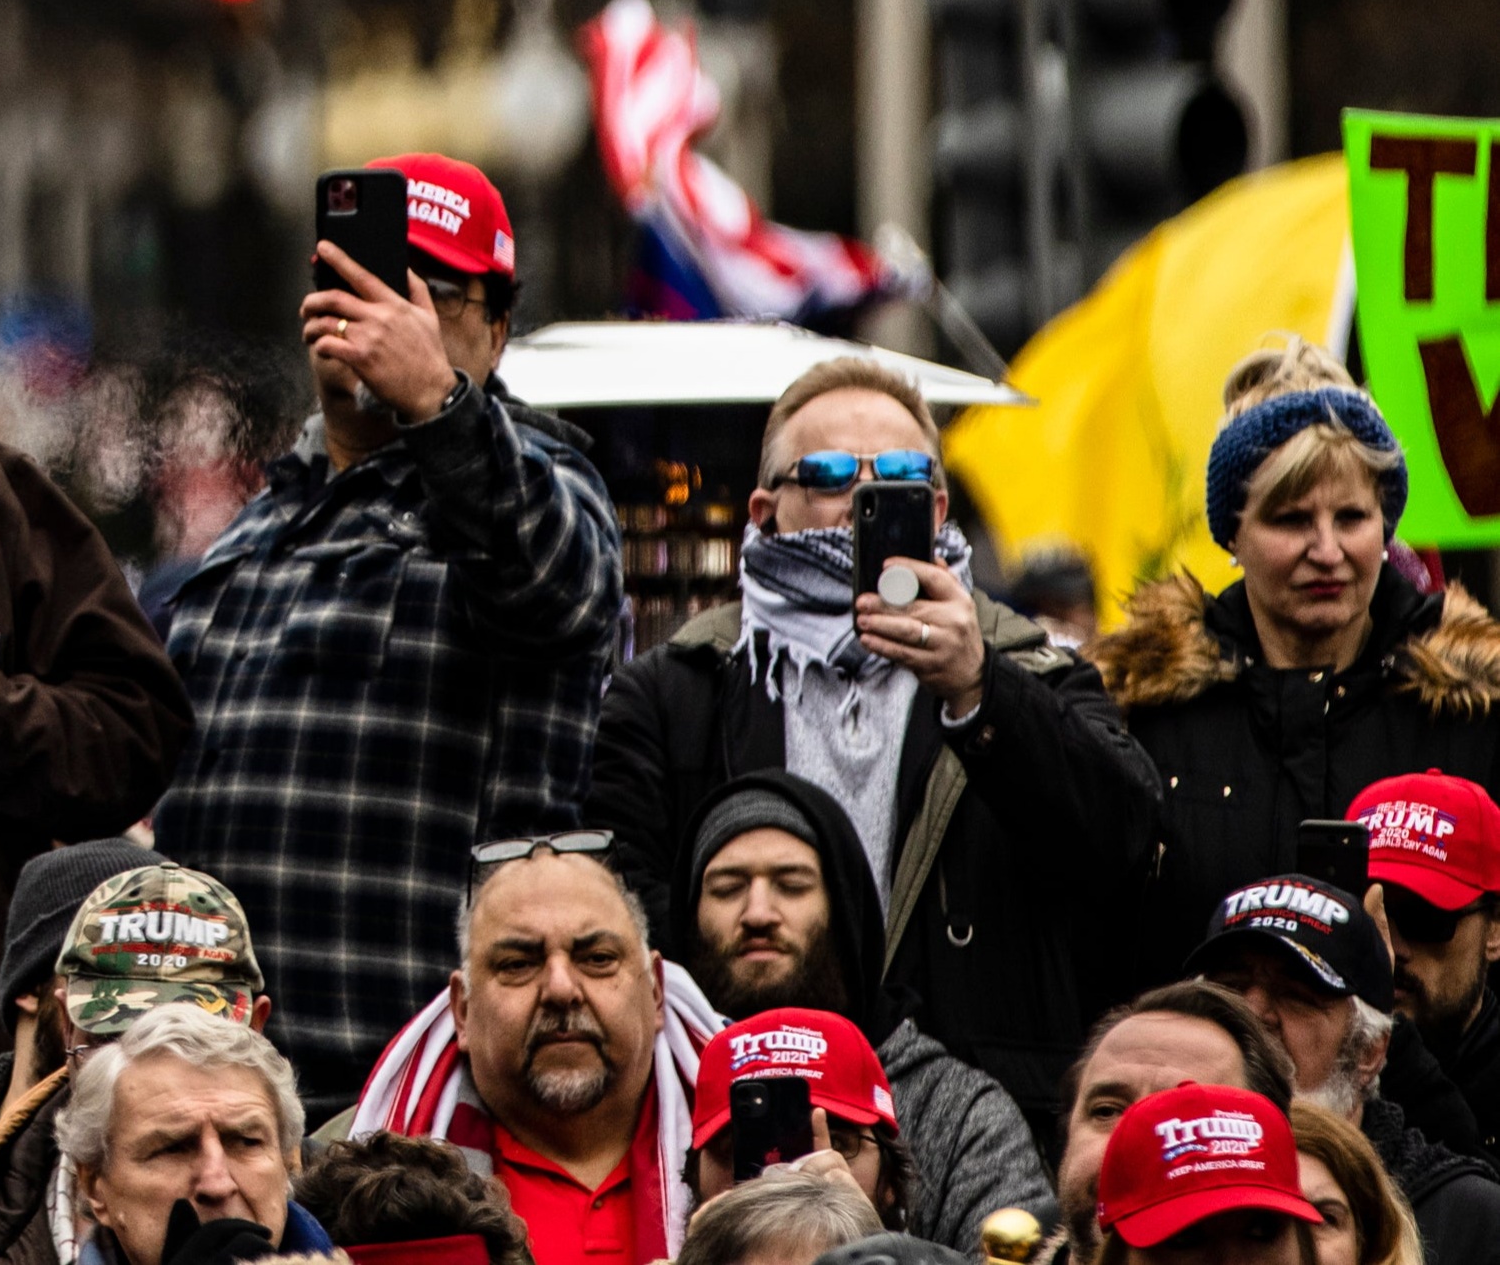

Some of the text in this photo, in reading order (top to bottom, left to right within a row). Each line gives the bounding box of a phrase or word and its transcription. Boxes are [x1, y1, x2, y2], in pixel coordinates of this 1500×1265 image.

[407, 178, 471, 220] MERICA
[1370, 136, 1500, 302] T
[1422, 844, 1449, 863] AGAIN
[1224, 884, 1350, 926] TRUMP
[99, 911, 230, 947] TRUMP
[1250, 916, 1298, 932] 2020
[137, 953, 188, 969] 2020
[730, 1030, 828, 1061] Trump
[770, 1051, 809, 1065] 2020
[1154, 1117, 1264, 1150] Trump
[1210, 1139, 1249, 1154] 2020
[1167, 1158, 1266, 1180] KEEP AMERICA GREAT
